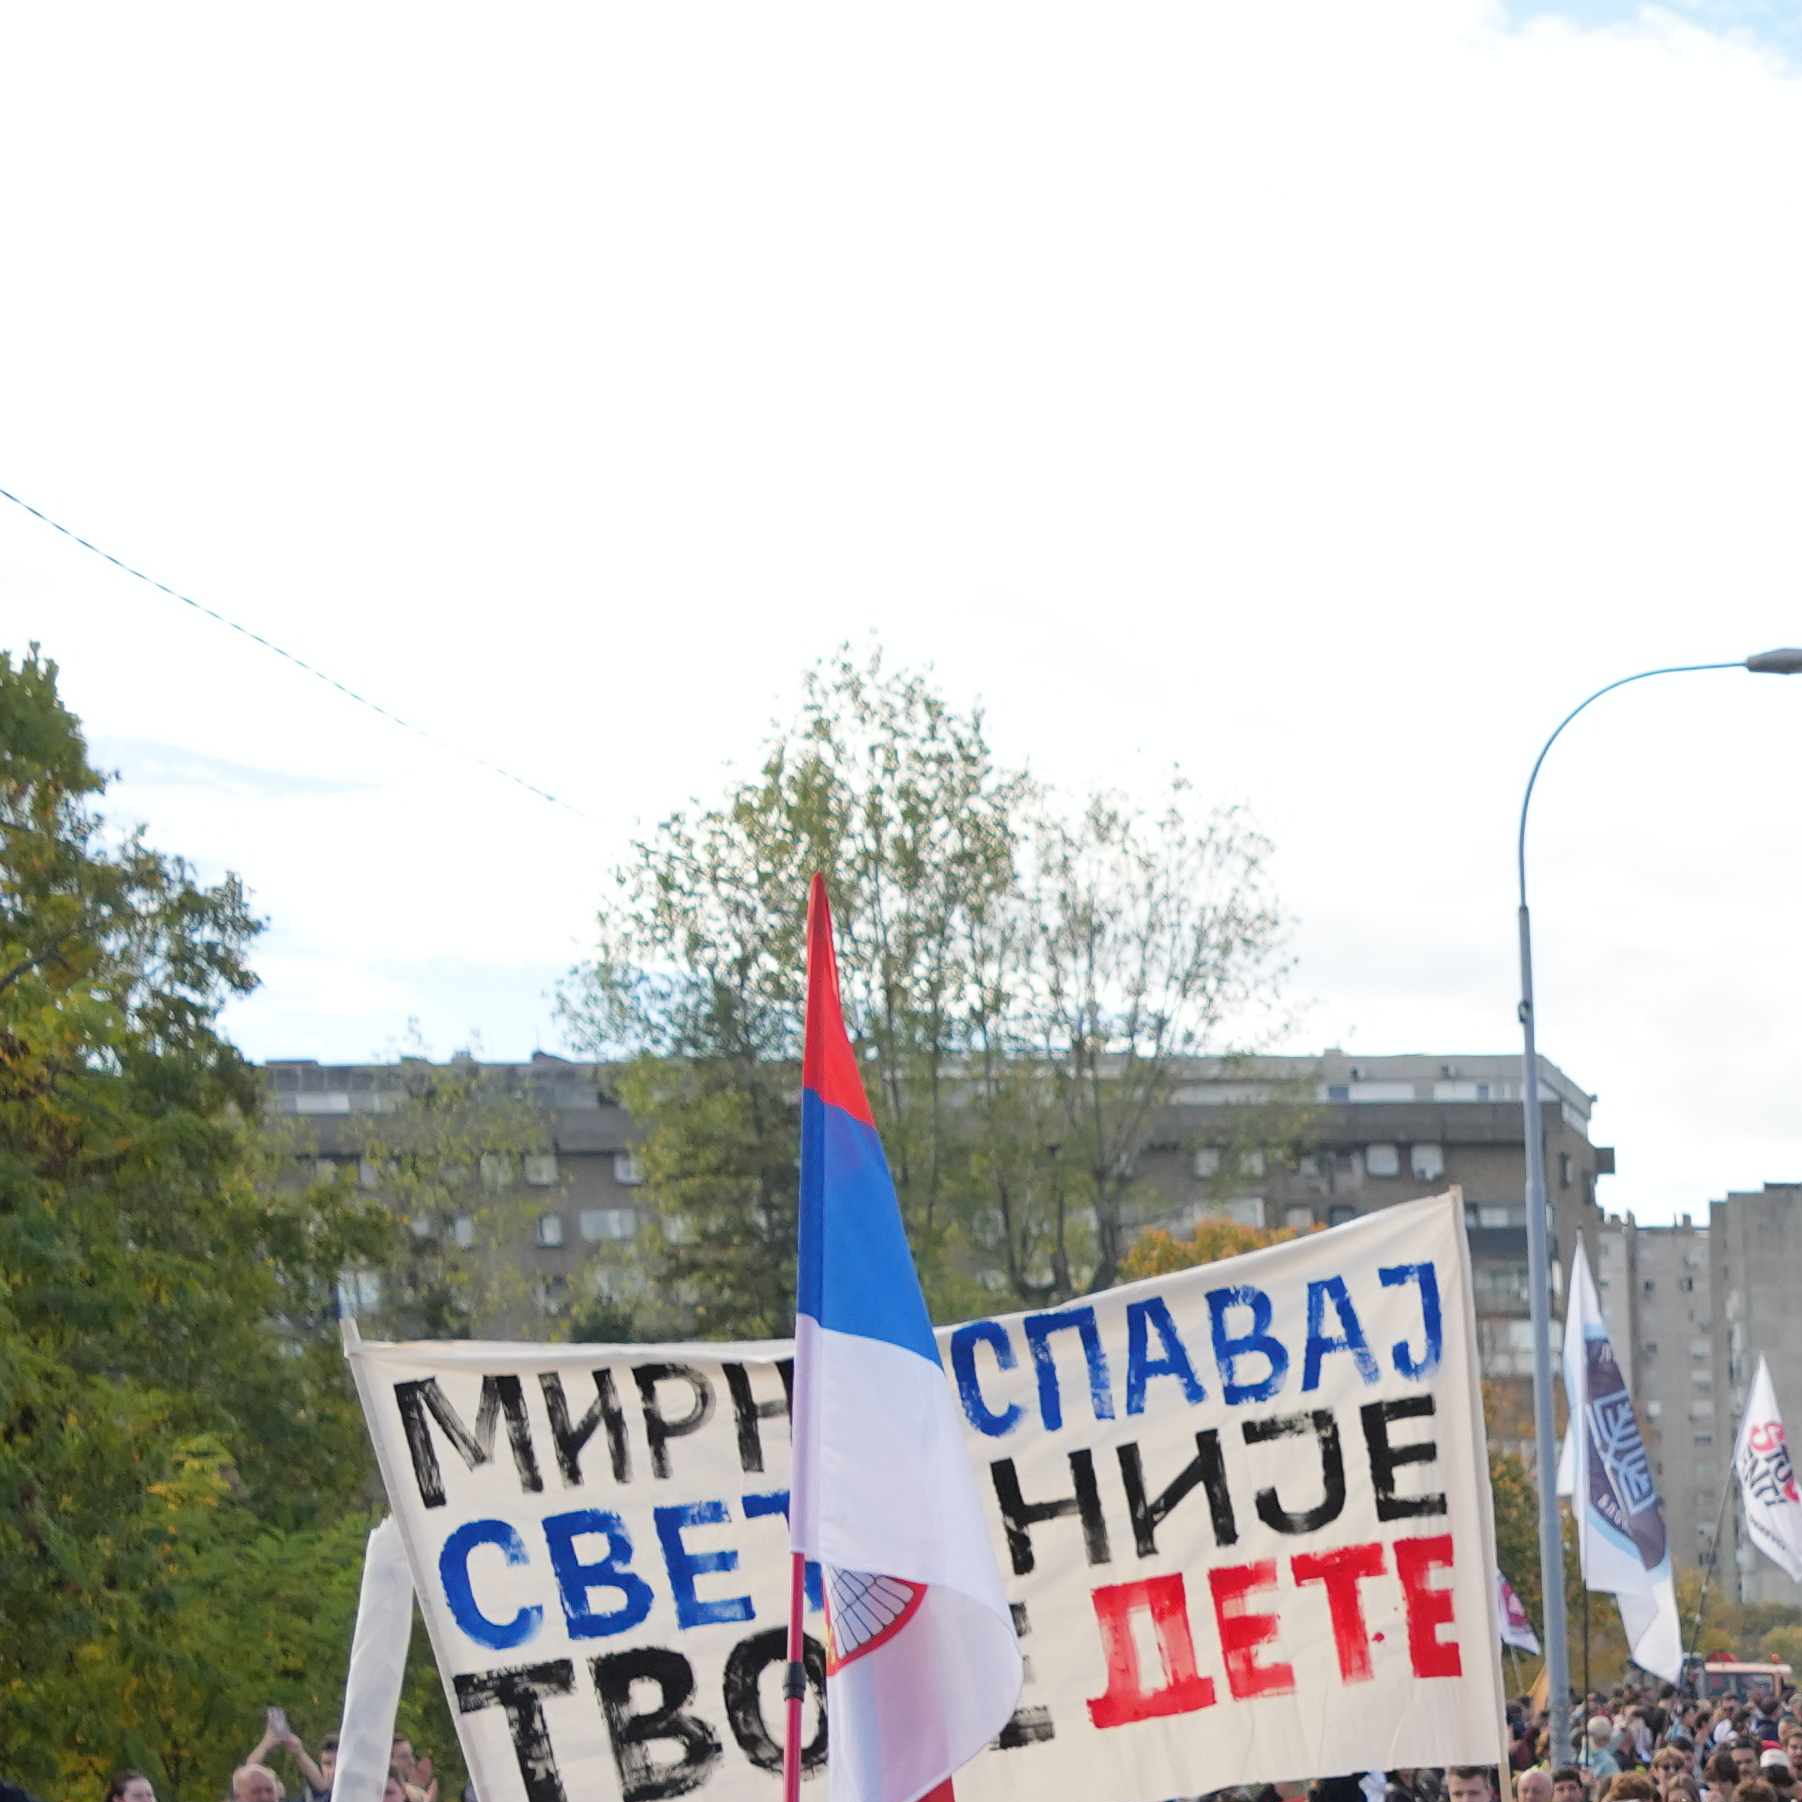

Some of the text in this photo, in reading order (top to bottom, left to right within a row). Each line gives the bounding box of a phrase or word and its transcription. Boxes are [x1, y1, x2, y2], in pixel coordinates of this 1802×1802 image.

[394, 1260, 1444, 1509] МИРН СПАВАЈ
[990, 1395, 1448, 1576] НИЈЕ
[1086, 1533, 1463, 1729] ДЕТЕ
